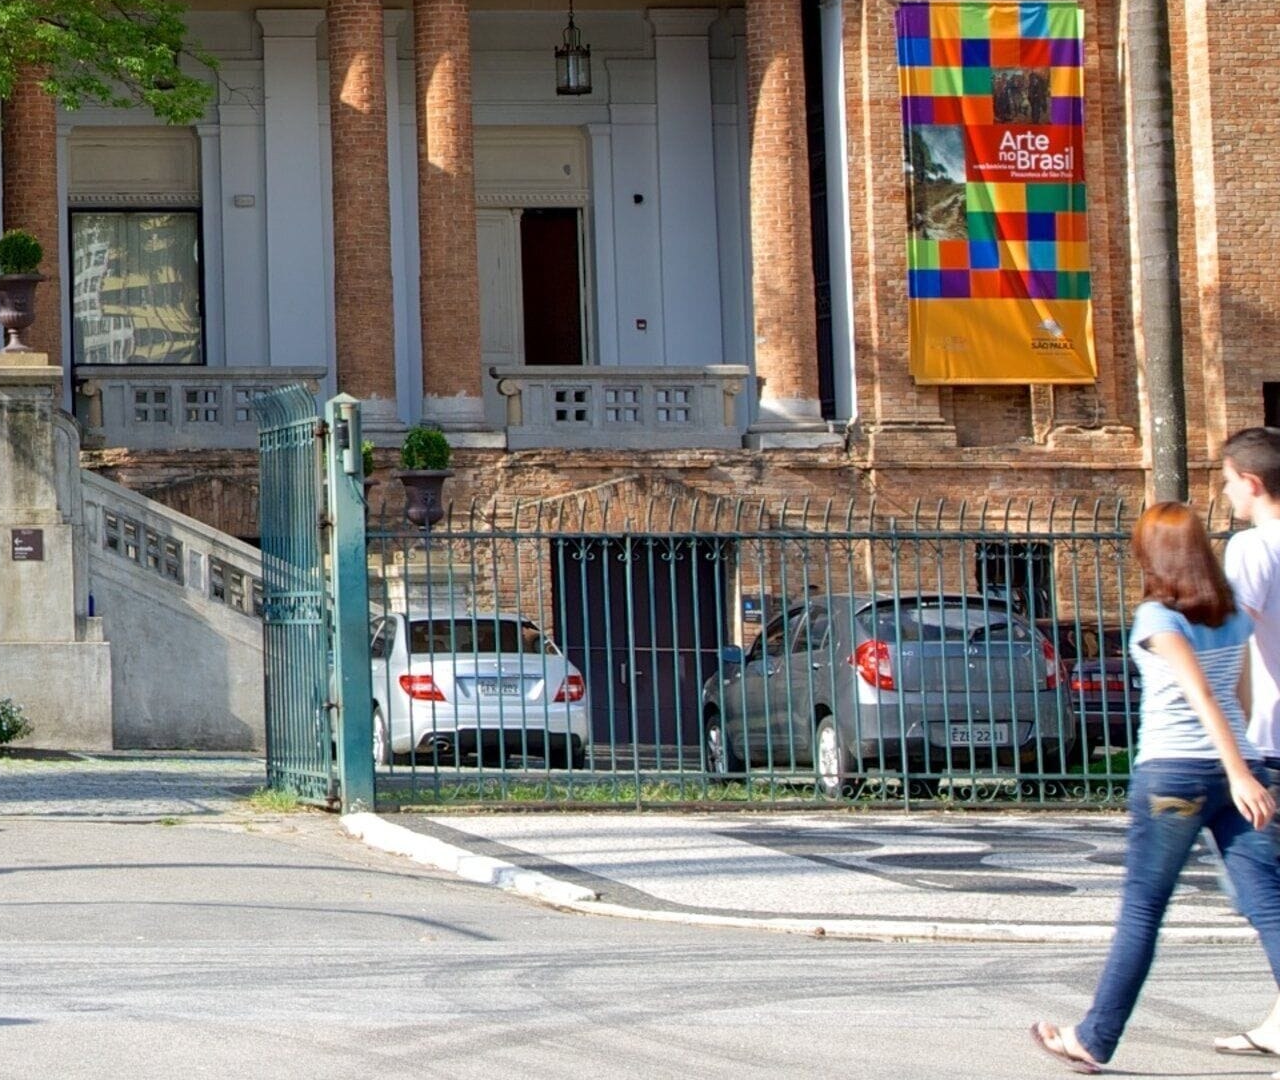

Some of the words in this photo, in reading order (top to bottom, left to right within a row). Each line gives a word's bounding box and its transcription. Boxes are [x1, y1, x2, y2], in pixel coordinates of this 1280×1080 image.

[999, 130, 1050, 151] Arte
[999, 151, 1016, 161] no
[1017, 146, 1074, 170] Brasil
